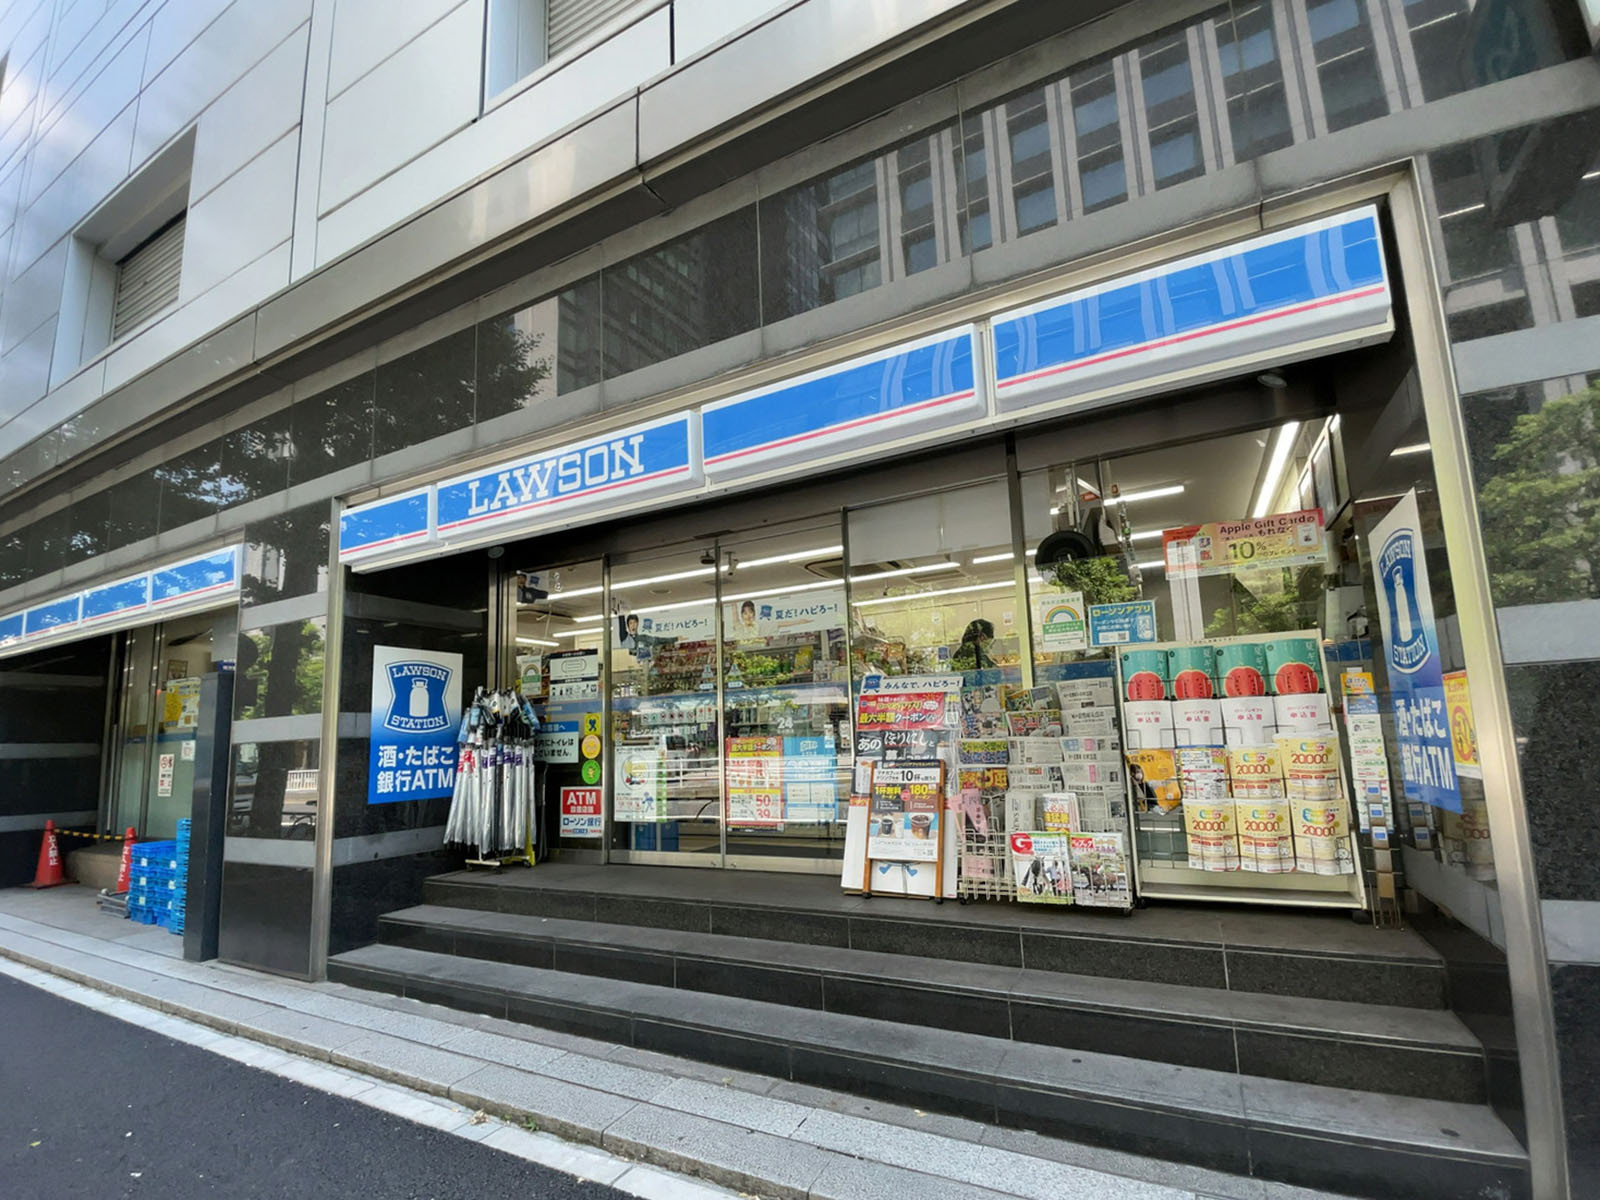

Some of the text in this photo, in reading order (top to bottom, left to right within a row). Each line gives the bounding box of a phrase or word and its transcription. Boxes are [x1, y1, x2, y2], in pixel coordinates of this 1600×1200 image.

[467, 434, 645, 516] LAWSON
[1220, 523, 1251, 535] Apple
[1254, 519, 1275, 529] Gift
[1380, 540, 1412, 576] LAWSON
[1092, 605, 1151, 617] ローソンアプリ
[1393, 634, 1428, 665] STATION
[393, 664, 447, 681] LAWSON
[391, 714, 444, 730] STATION
[777, 718, 794, 729] 24
[1395, 697, 1447, 739] 酒・たばこ
[858, 738, 882, 751] あの
[377, 744, 454, 768] 酒・たばこ
[1400, 743, 1454, 791] 銀行ATM
[377, 769, 454, 794] 銀行ATM
[567, 792, 597, 805] ATM
[756, 795, 771, 807] 50
[562, 817, 602, 827] ローソン銀行
